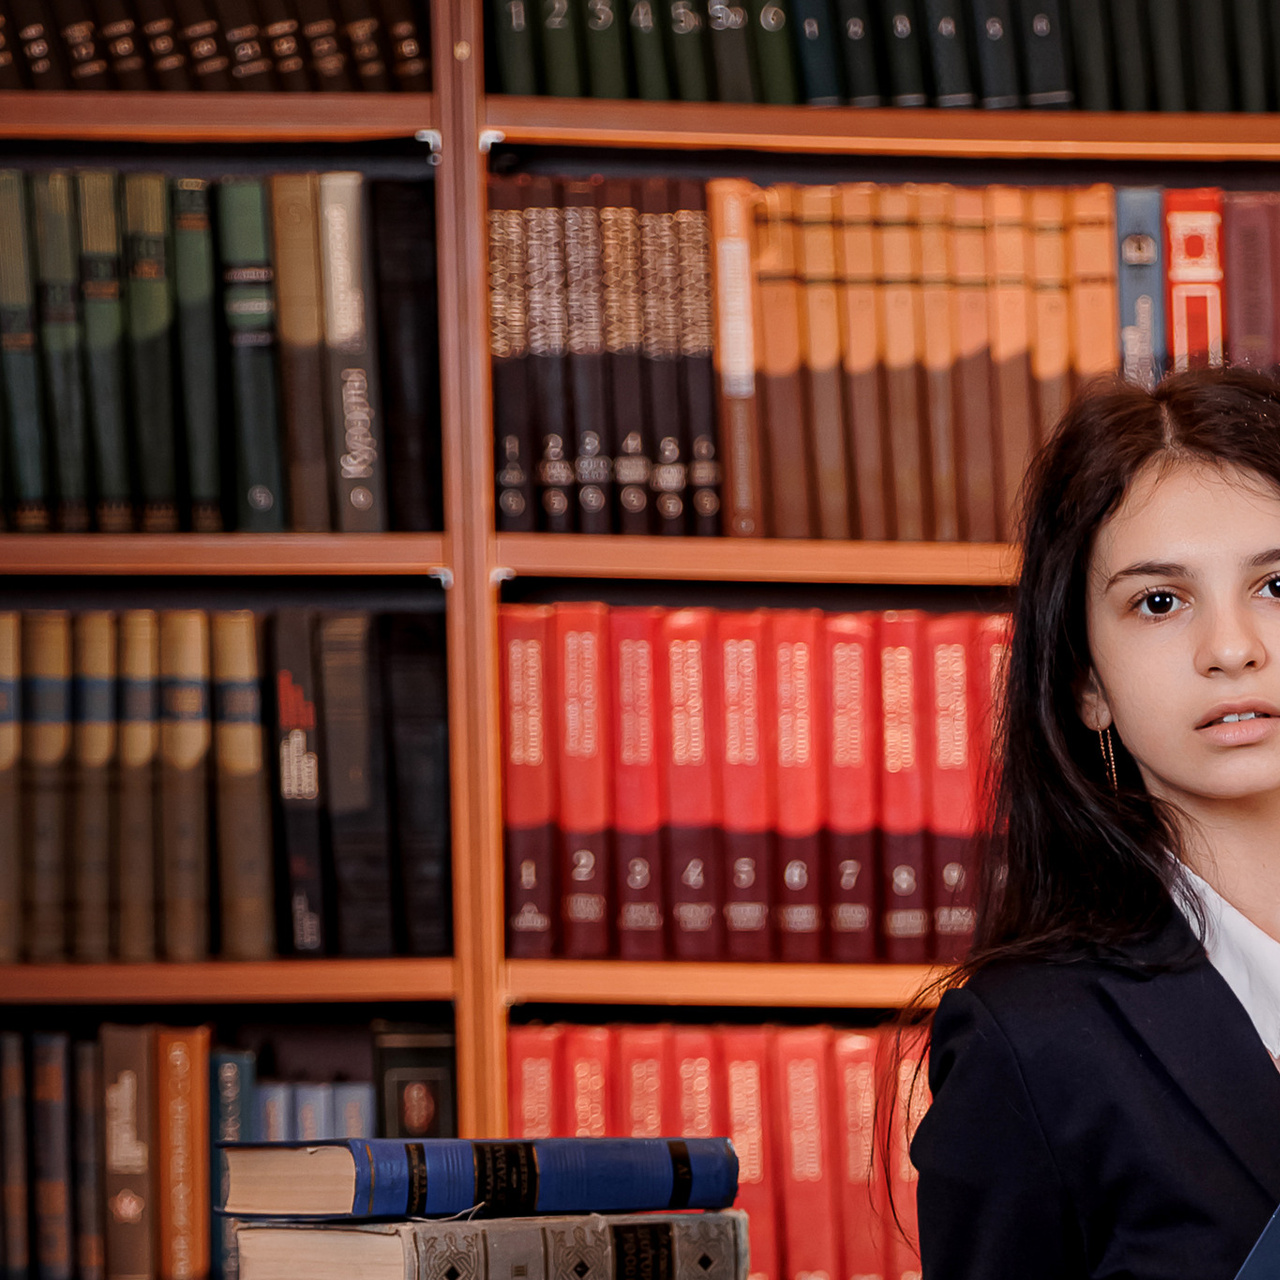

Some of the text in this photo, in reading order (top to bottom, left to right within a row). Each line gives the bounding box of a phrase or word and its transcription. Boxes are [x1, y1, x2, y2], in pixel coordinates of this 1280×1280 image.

[521, 859, 537, 889] 1
[572, 850, 595, 881] 2
[627, 858, 650, 889] 3
[681, 858, 704, 889] 4
[734, 858, 755, 889] 5
[838, 860, 862, 890] 7
[511, 1264, 527, 1278] III
